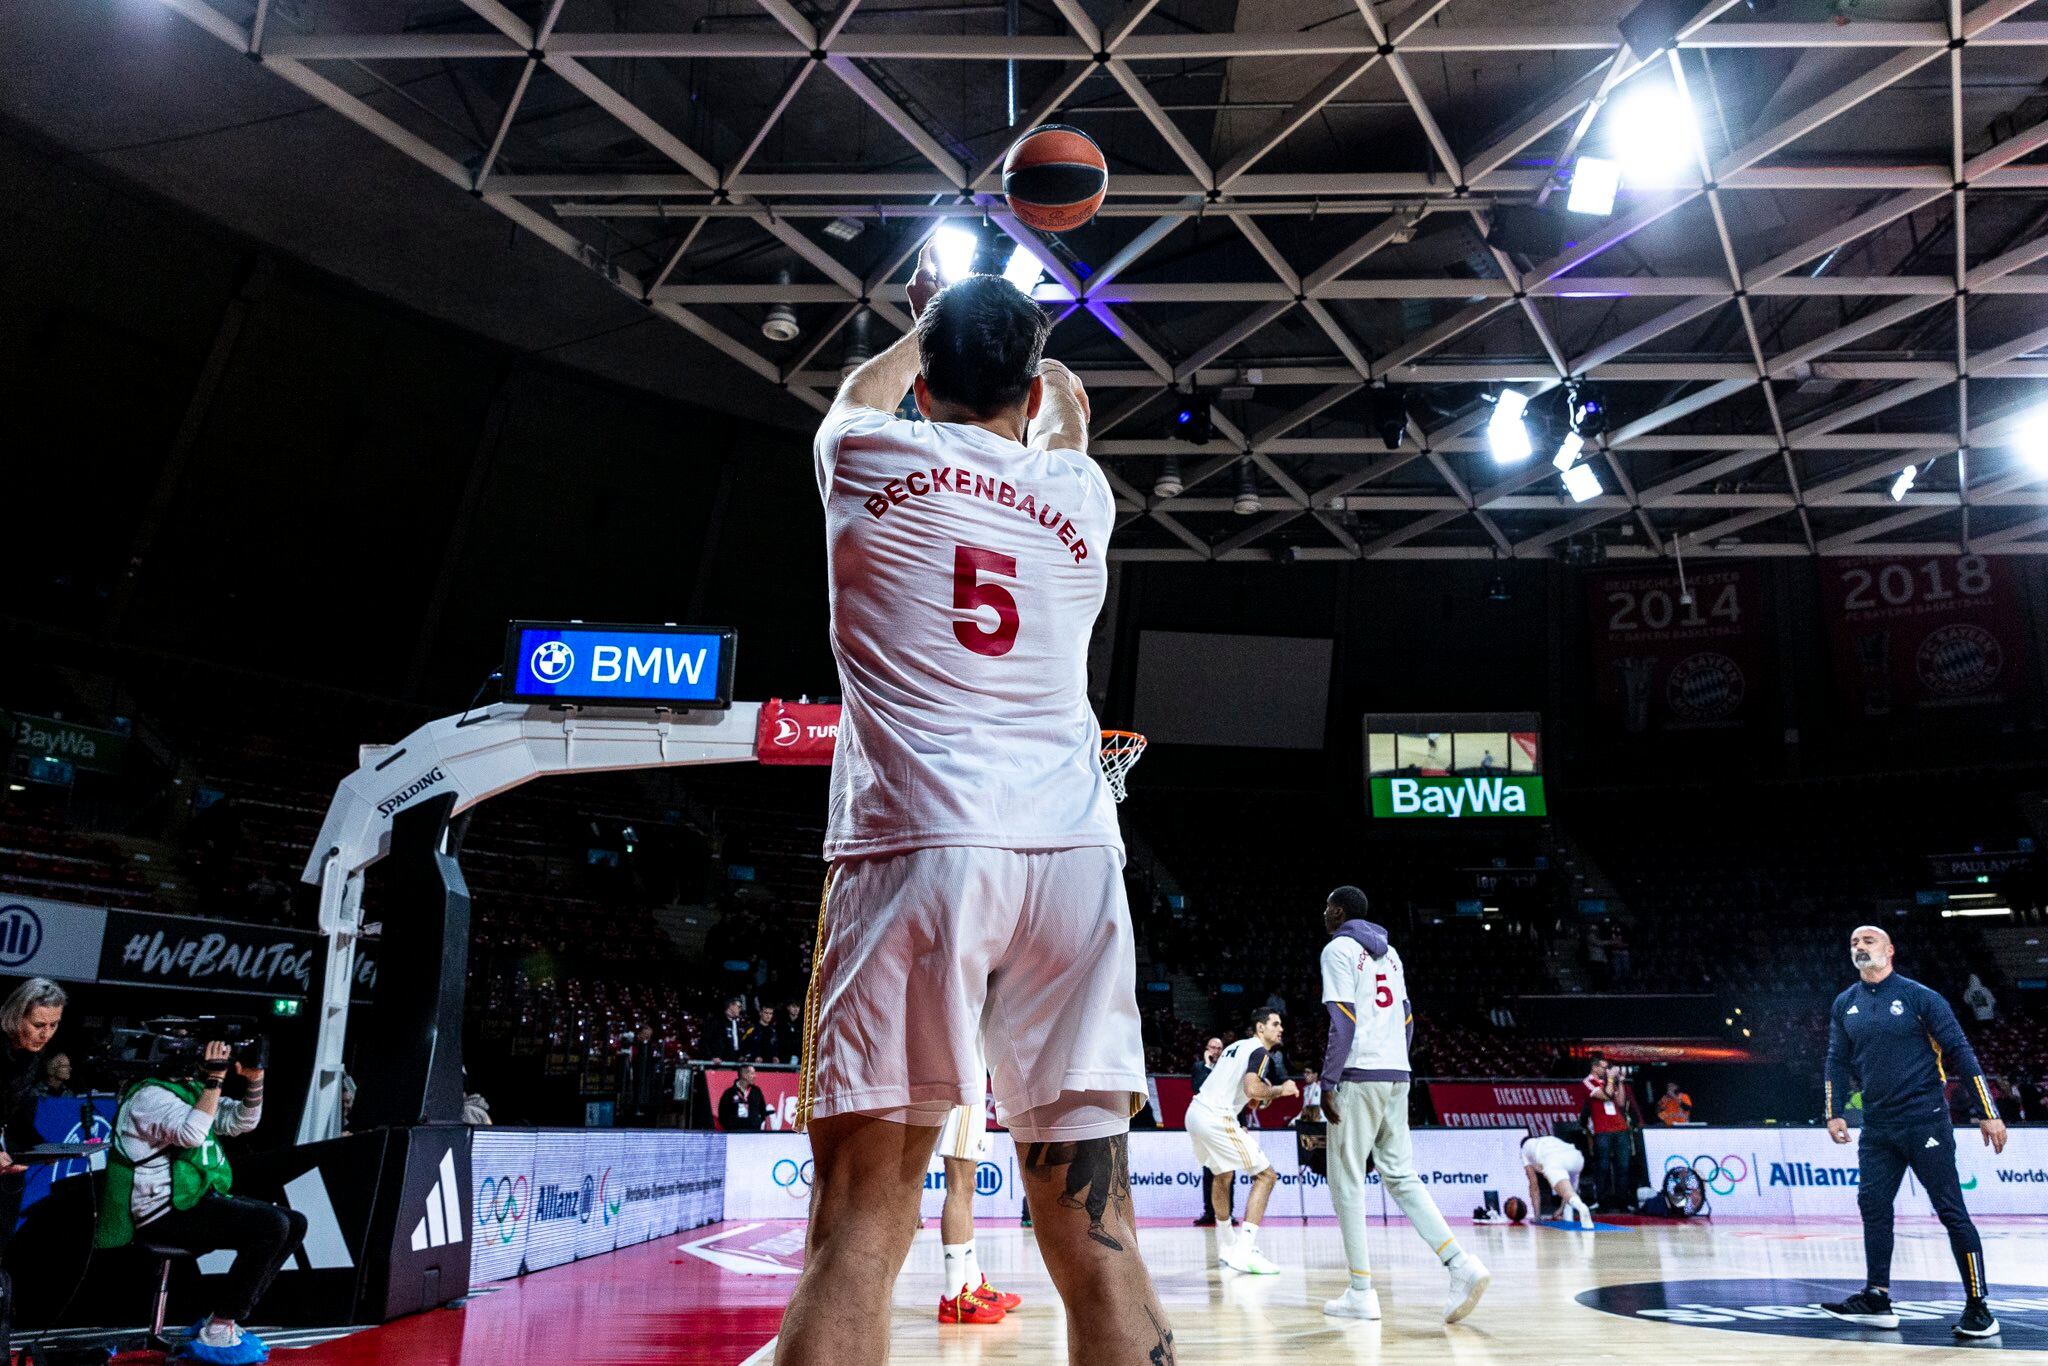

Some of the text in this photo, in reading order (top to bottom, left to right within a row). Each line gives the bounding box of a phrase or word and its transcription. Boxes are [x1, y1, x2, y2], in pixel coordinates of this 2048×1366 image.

[863, 467, 1088, 564] BECKENBAUER
[952, 545, 1020, 657] 5
[1840, 556, 1992, 610] 2018
[1608, 584, 1742, 631] 2014
[591, 645, 708, 685] BMW
[377, 766, 446, 819] SPALDING
[1389, 777, 1527, 818] BayWa
[1375, 974, 1394, 1008] 5
[1432, 1171, 1489, 1184] Partner
[1769, 1162, 1861, 1187] Allianz
[535, 1183, 580, 1222] Allianz
